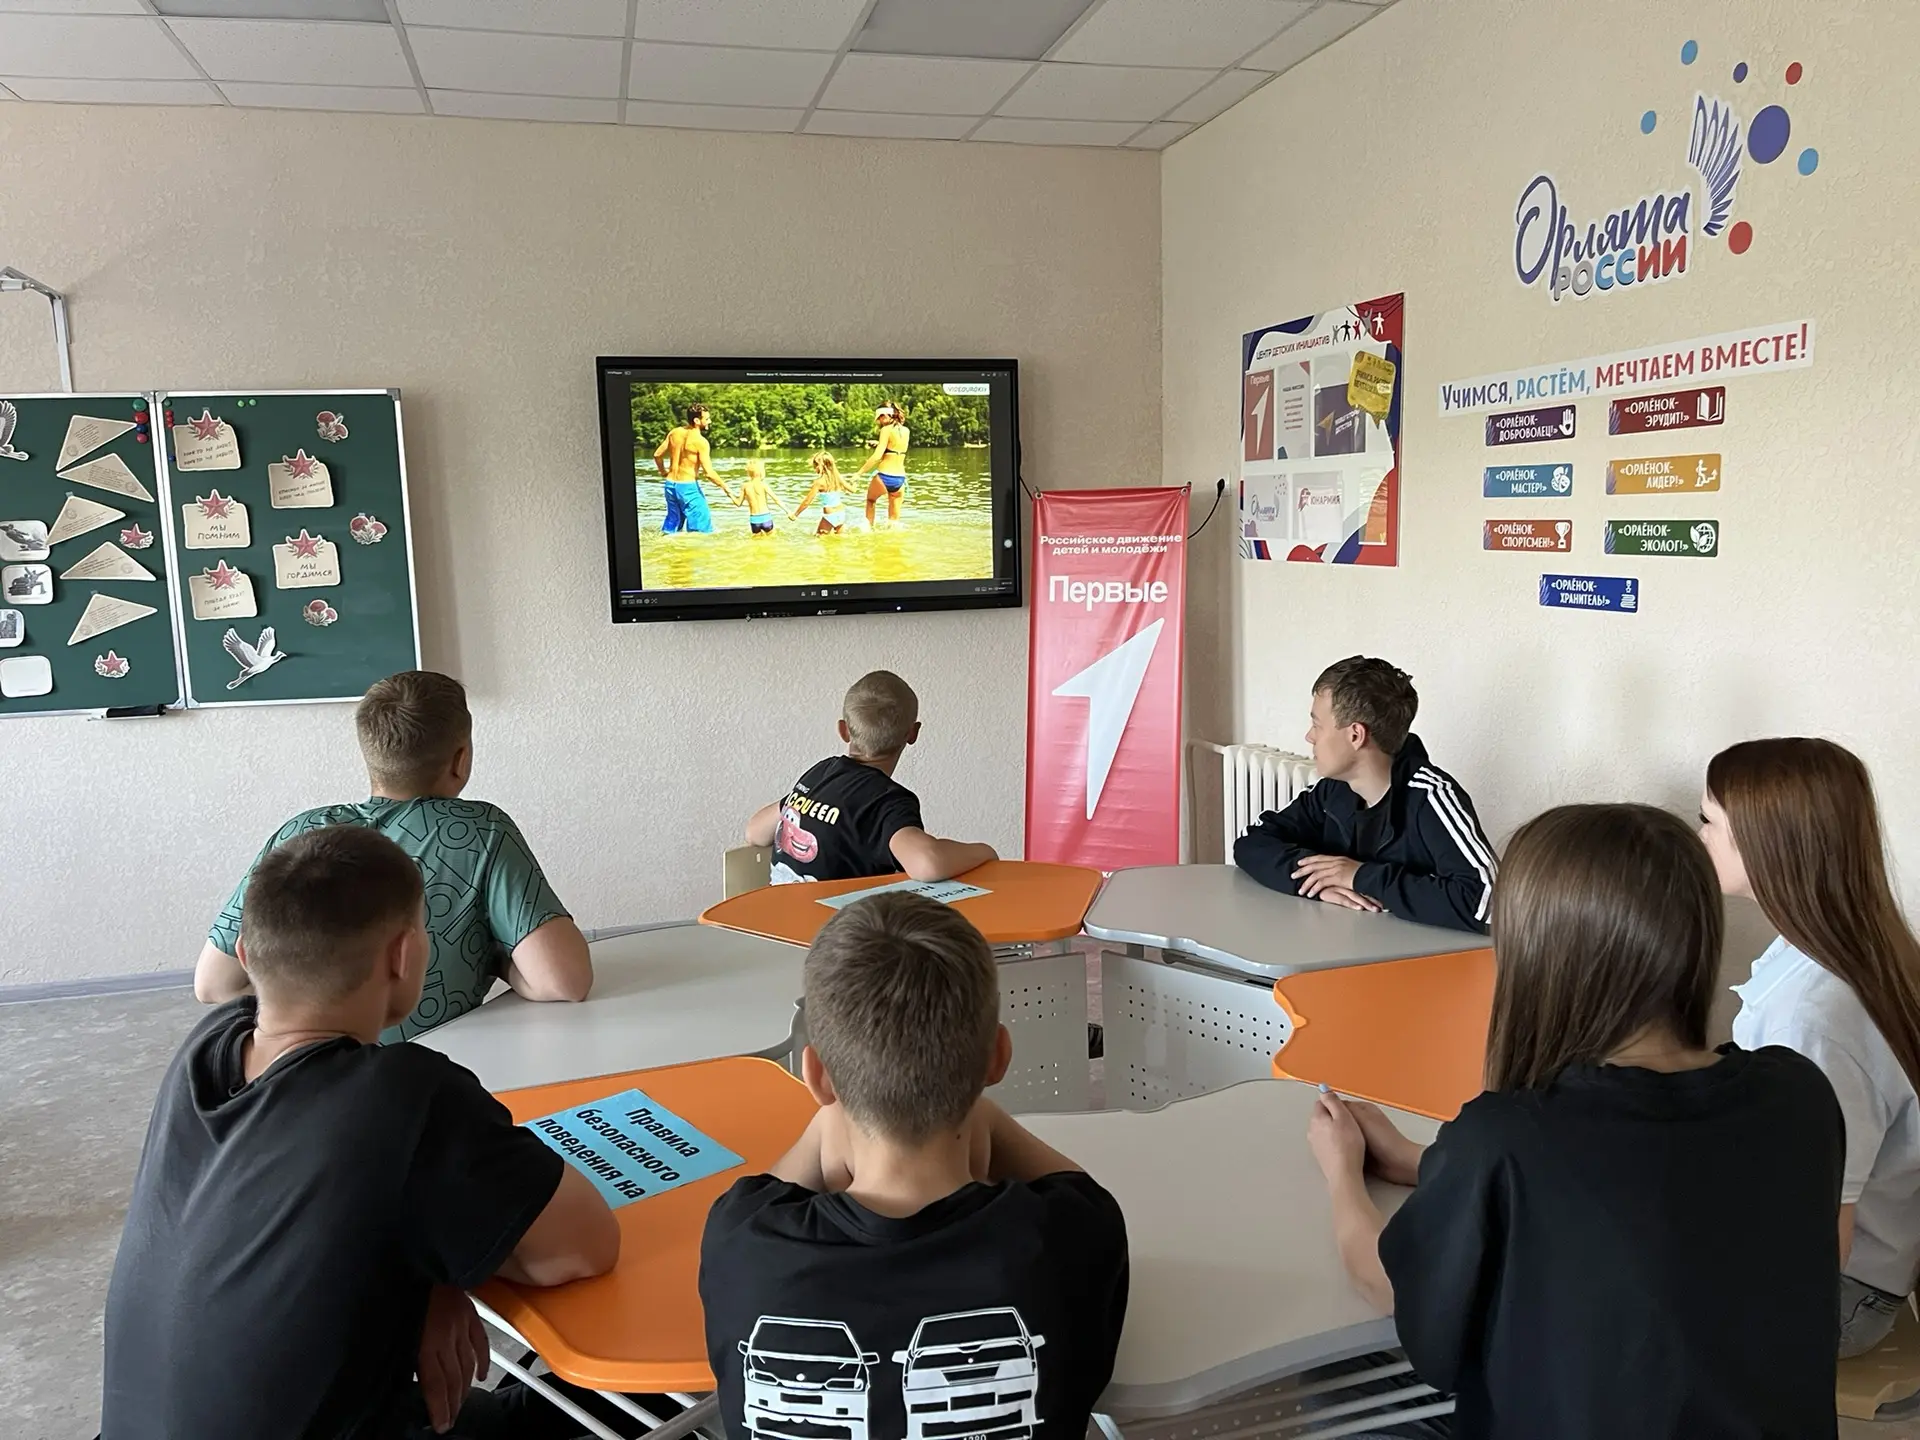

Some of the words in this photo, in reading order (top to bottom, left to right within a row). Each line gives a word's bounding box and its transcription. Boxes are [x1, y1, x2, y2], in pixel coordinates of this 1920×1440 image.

[1516, 176, 1690, 289] Орлята
[1553, 235, 1687, 301] РОССИИ
[1516, 367, 1591, 400] РАСТЁМ,
[1595, 350, 1695, 388] МЕЧТАЕМ
[1700, 323, 1808, 373] ВМЕСТЕ!
[1250, 374, 1270, 387] Первые
[1624, 397, 1679, 414] «ОРЛЁНОК-
[1645, 411, 1689, 427] ЭРУДИТ!»
[1620, 461, 1674, 476] «ОРЛЁНОК-
[1646, 475, 1684, 489] ЛИДЕР!»
[197, 532, 240, 540] ПОМНИМ
[1618, 522, 1671, 537] «ОРЛЁНОК-
[1040, 535, 1115, 545] Российское
[1116, 534, 1182, 545] движение
[1640, 539, 1689, 552] ЭКОЛОГ!»
[1052, 546, 1089, 555] детей
[1091, 546, 1100, 554] и
[1101, 544, 1168, 555] молодёжи
[286, 570, 332, 579] ГОРДИМСЯ
[1049, 575, 1168, 612] Первые
[785, 790, 840, 825] CQUEEN
[624, 1107, 701, 1158] Правила
[576, 1108, 681, 1182] безопасного
[535, 1118, 624, 1181] поведения
[613, 1179, 646, 1200] на
